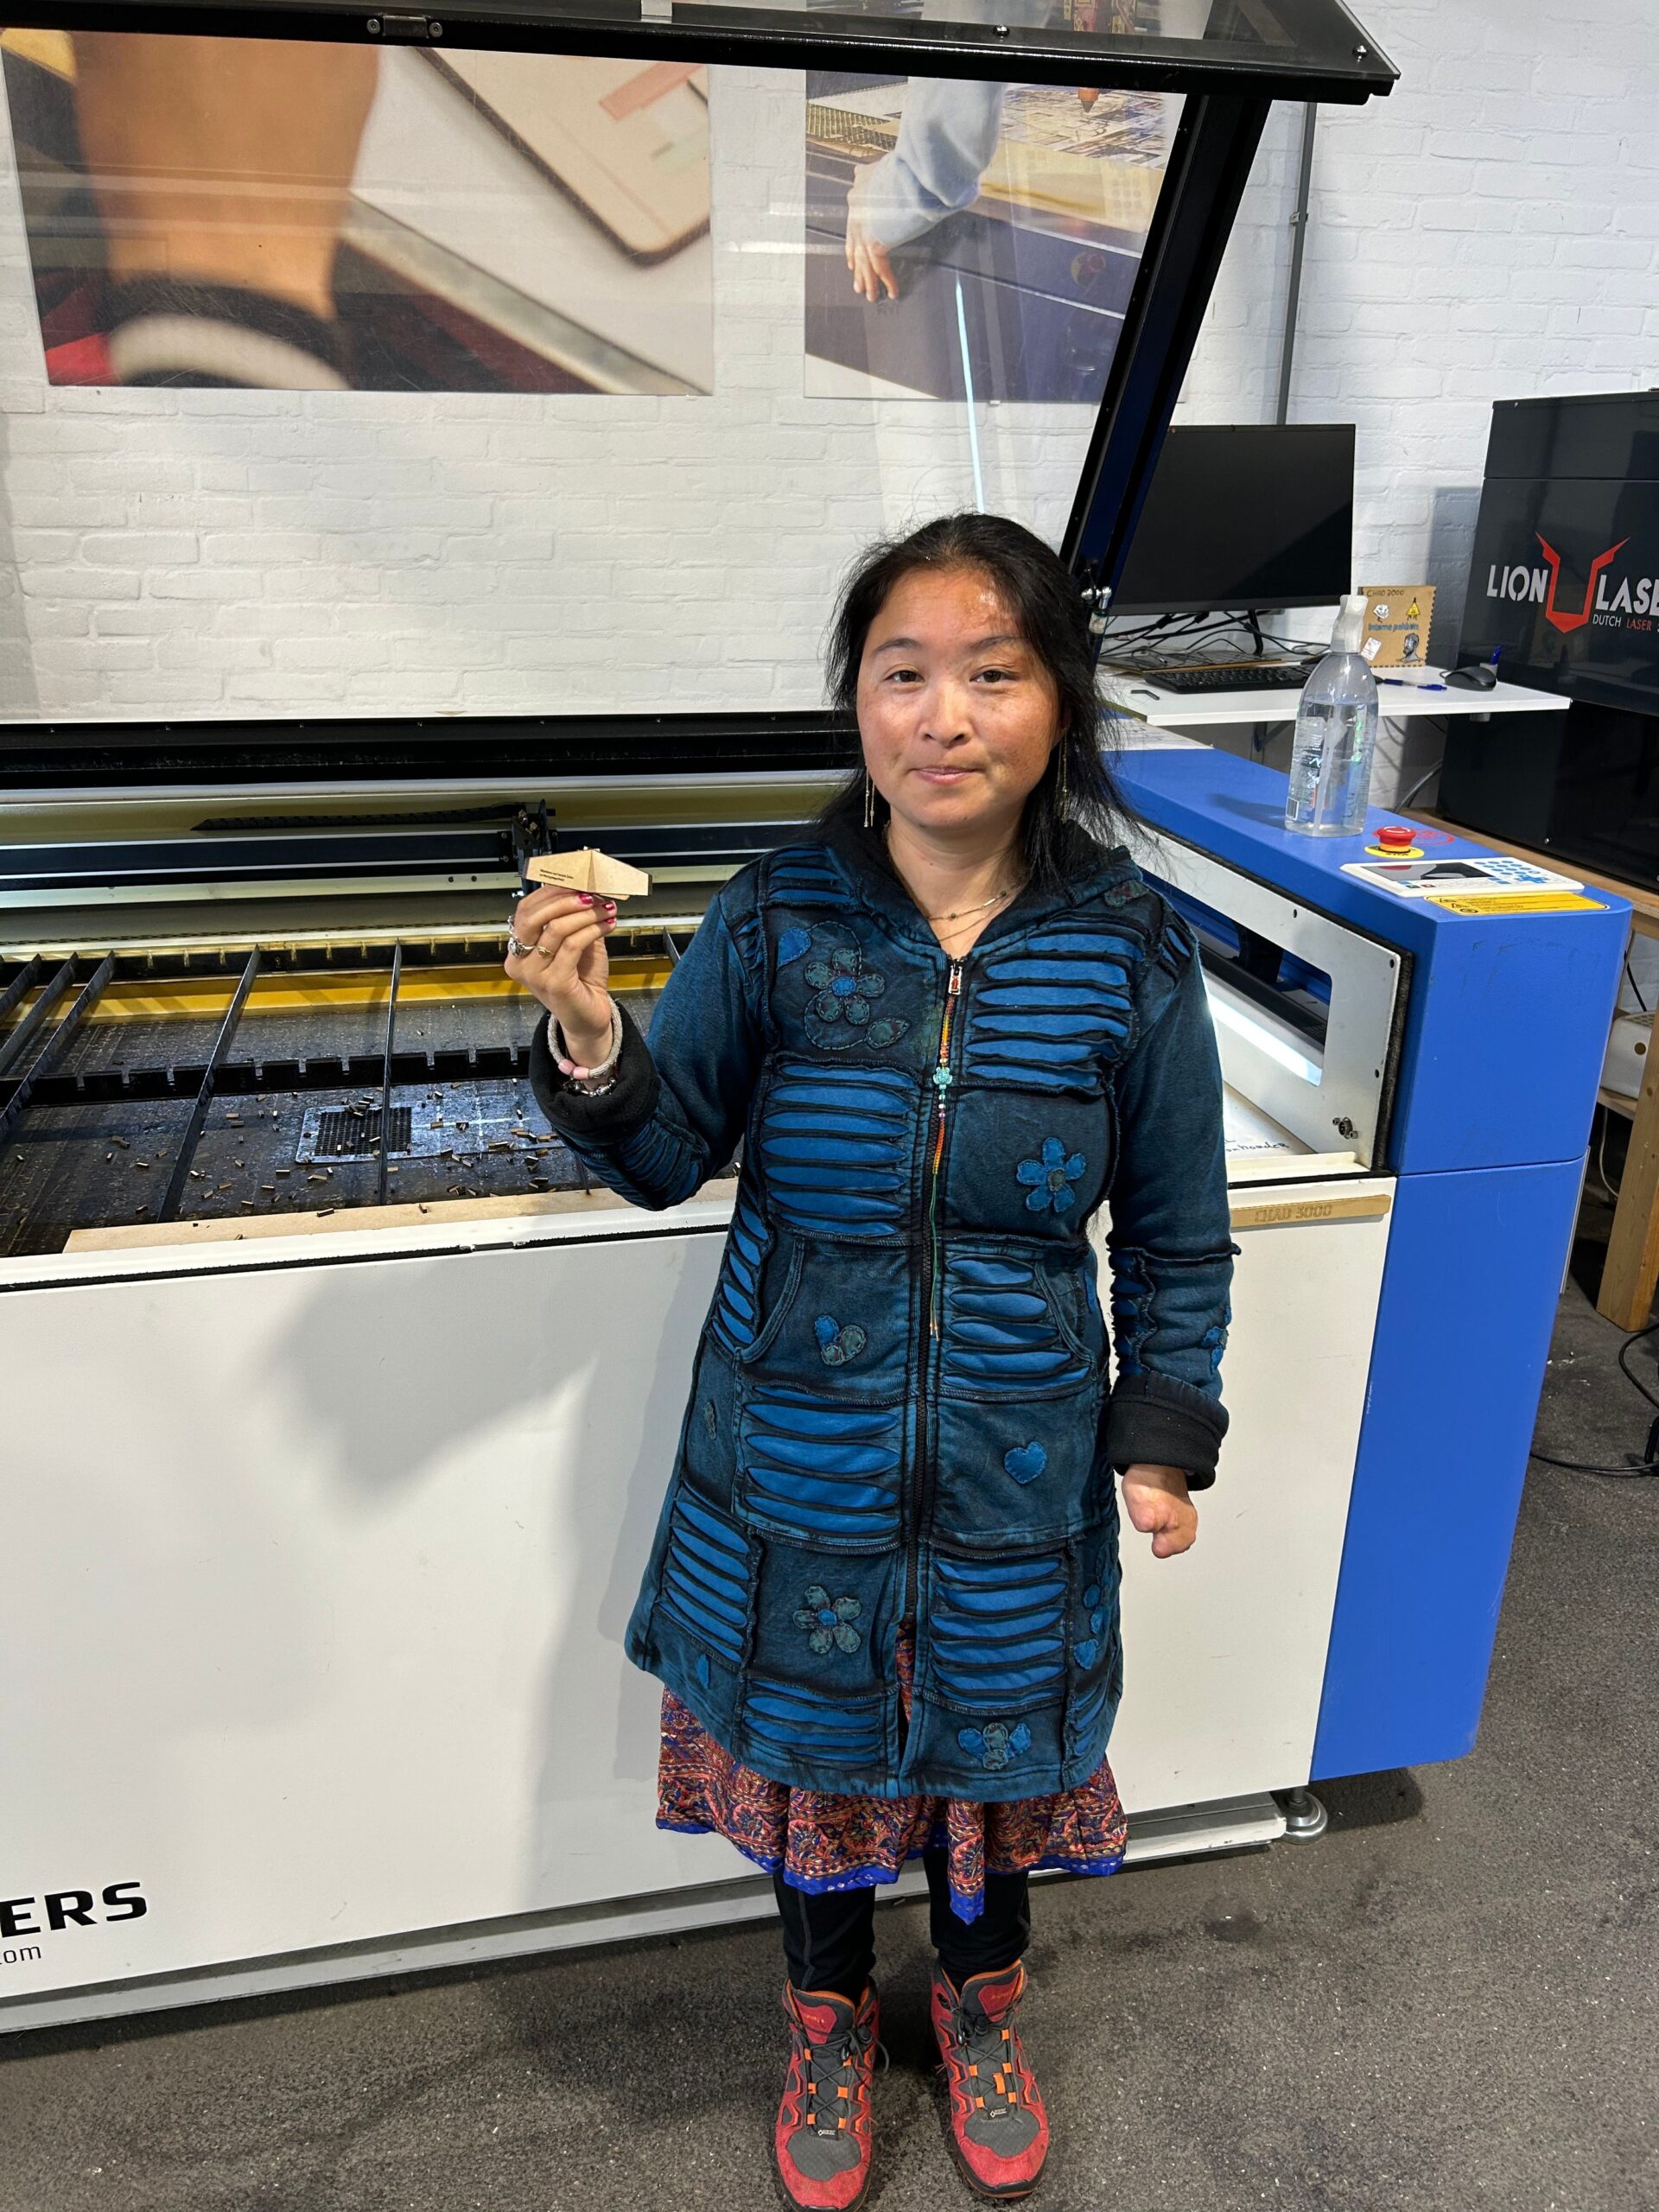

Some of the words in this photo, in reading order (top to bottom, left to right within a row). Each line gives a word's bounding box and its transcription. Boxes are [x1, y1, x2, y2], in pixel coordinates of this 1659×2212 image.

[1486, 564, 1548, 603] LION
[1592, 613, 1622, 627] DUTCH
[1626, 617, 1652, 631] LASER
[1295, 1204, 1332, 1219] 3000
[0, 1881, 147, 1938] ERS
